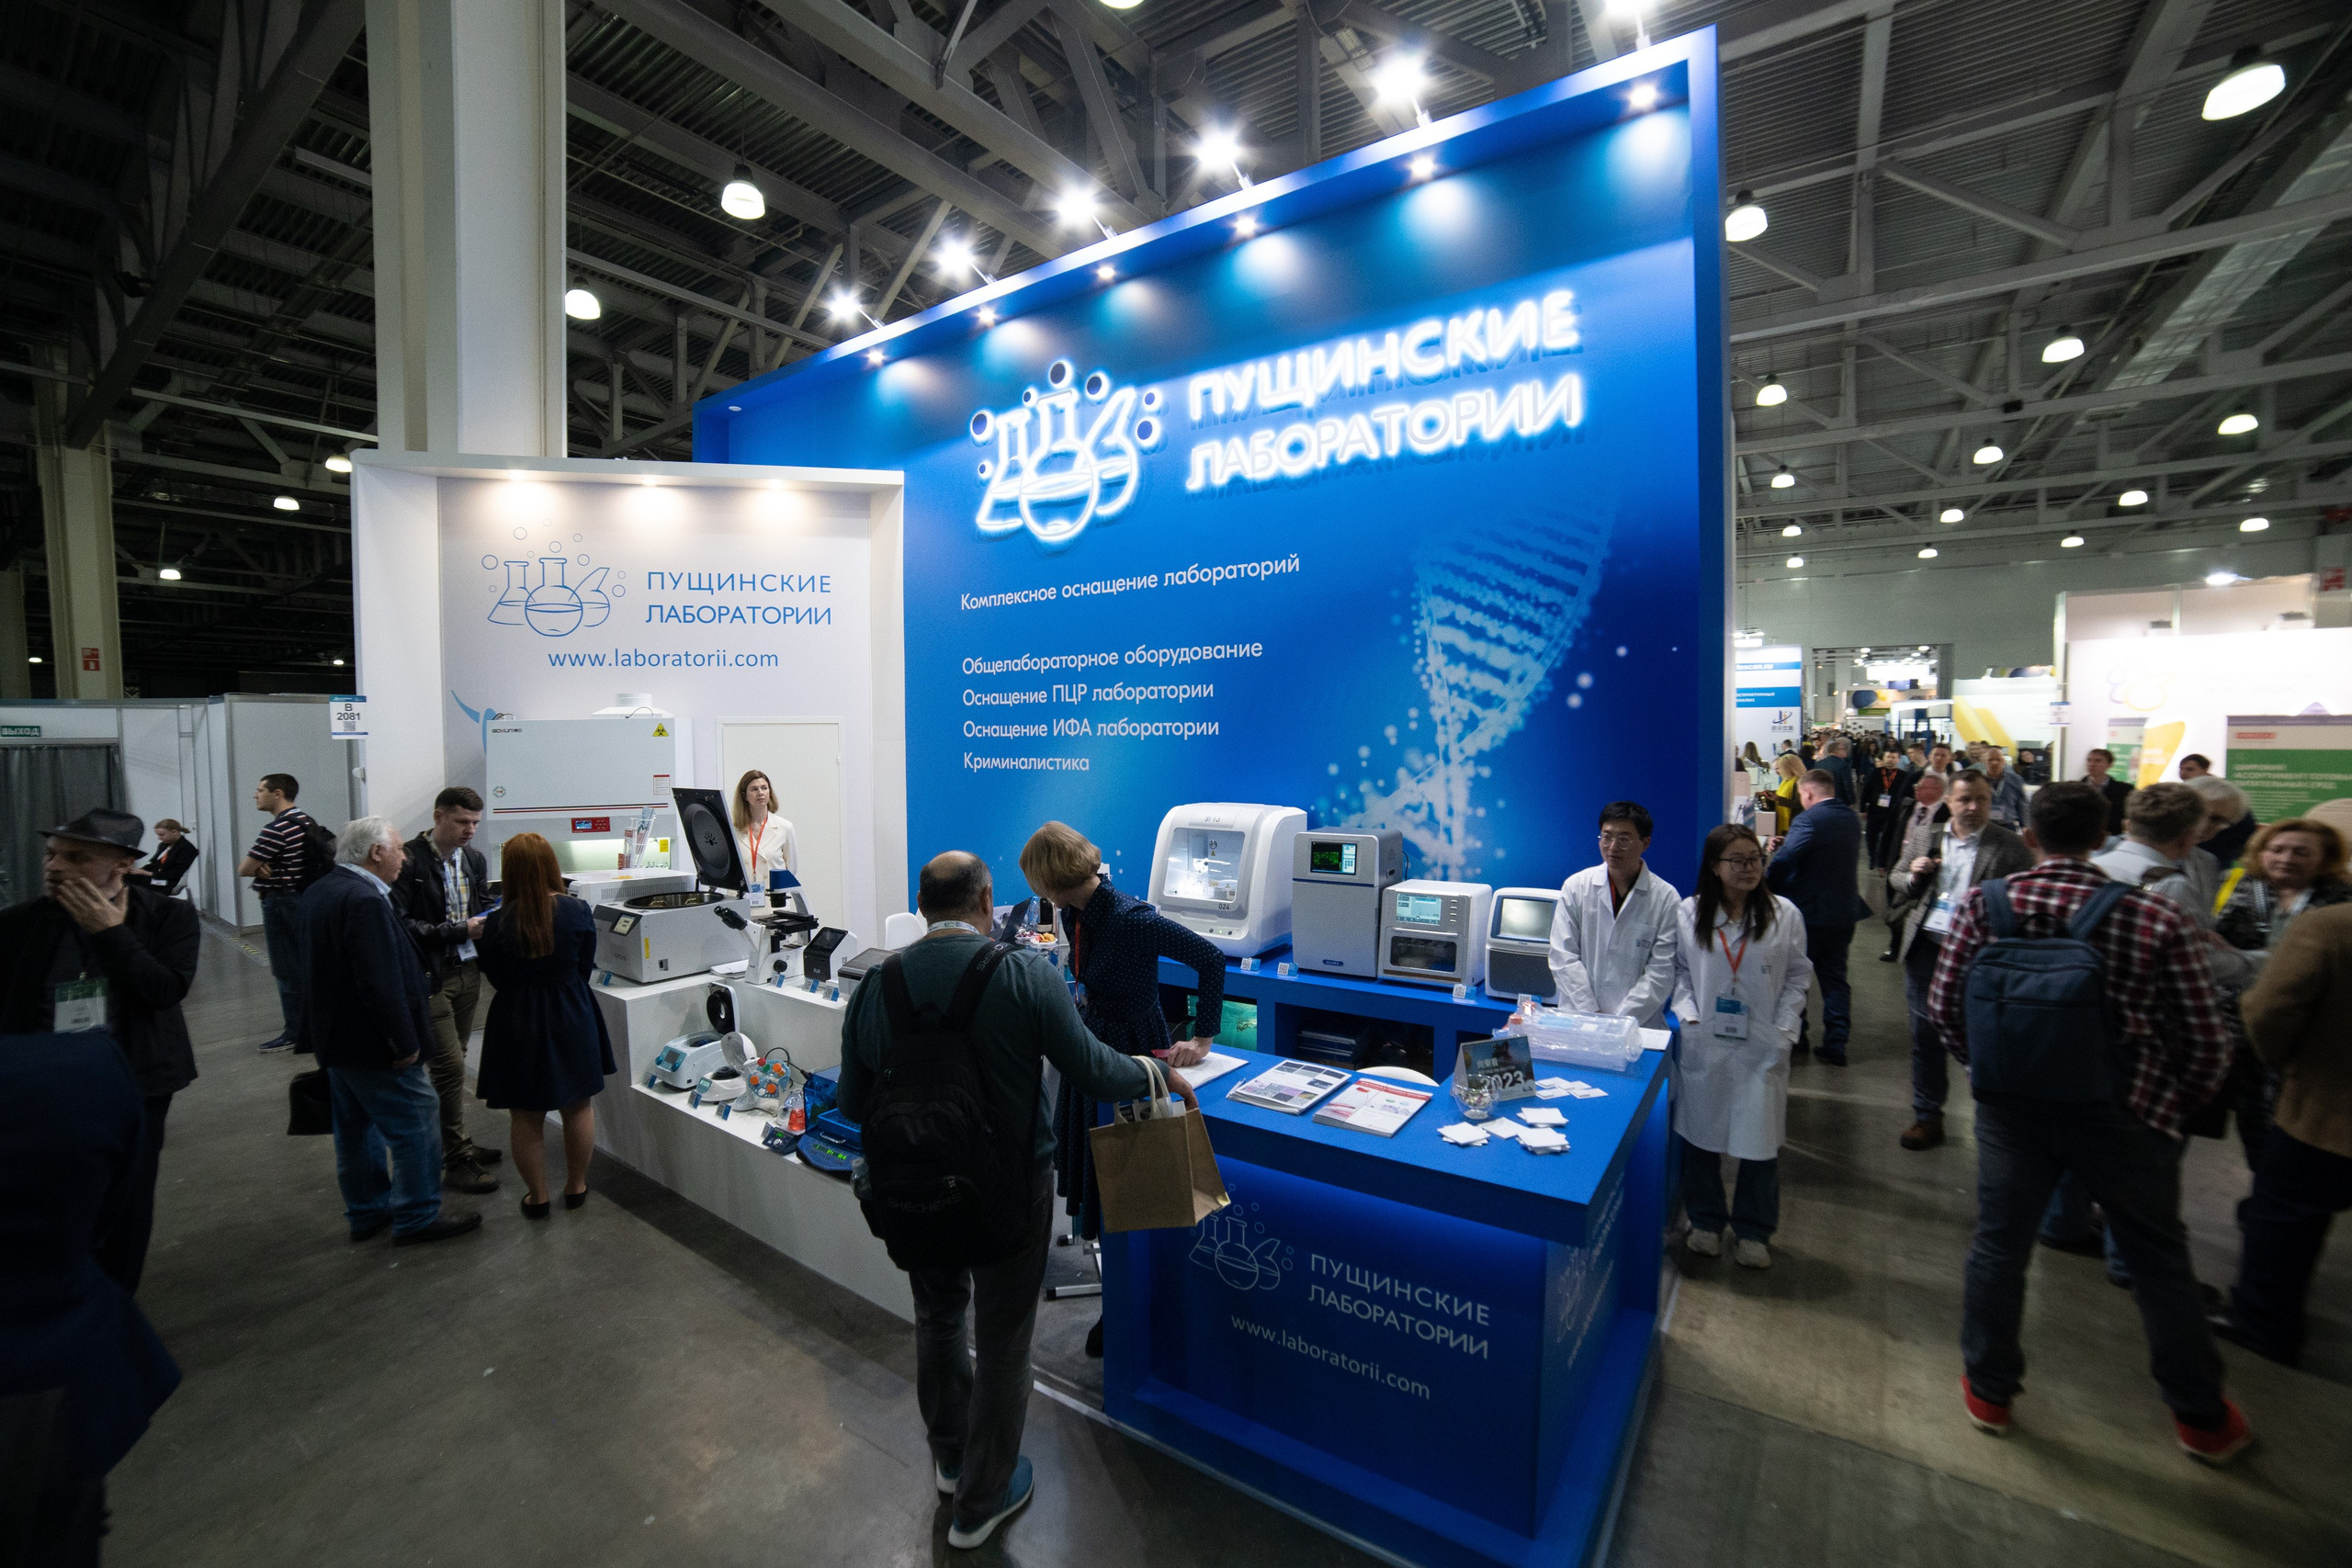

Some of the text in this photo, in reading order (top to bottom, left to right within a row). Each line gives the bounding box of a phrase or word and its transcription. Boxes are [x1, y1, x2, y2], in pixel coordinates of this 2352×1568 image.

[1188, 290, 1579, 420] ПУЩИНСКИЕ
[1186, 374, 1582, 490] ЛАБОРАТОРИИ
[647, 571, 831, 595] ПУЩИНСКИЕ
[961, 553, 1300, 611] Комплексное оснащение лабораторий
[645, 604, 831, 625] ЛАБОРАТОРИИ
[548, 648, 779, 667] www.laboratorii.com
[962, 641, 1263, 675] Общелабораторное оборудование
[963, 682, 1214, 706] Оснащение ПЦР лаборатории
[336, 712, 360, 720] 2081
[2, 727, 39, 737] ВЫХОД
[963, 717, 1219, 740] Оснащение ИФА лаборатории
[964, 752, 1090, 773] Криминалистика
[1479, 1070, 1525, 1094] 2023
[1311, 1253, 1489, 1326] ПУЩИНСКИЕ
[1308, 1284, 1487, 1359] ЛАБОРАТОРИИ
[1231, 1315, 1430, 1400] www.laboratorii.com
